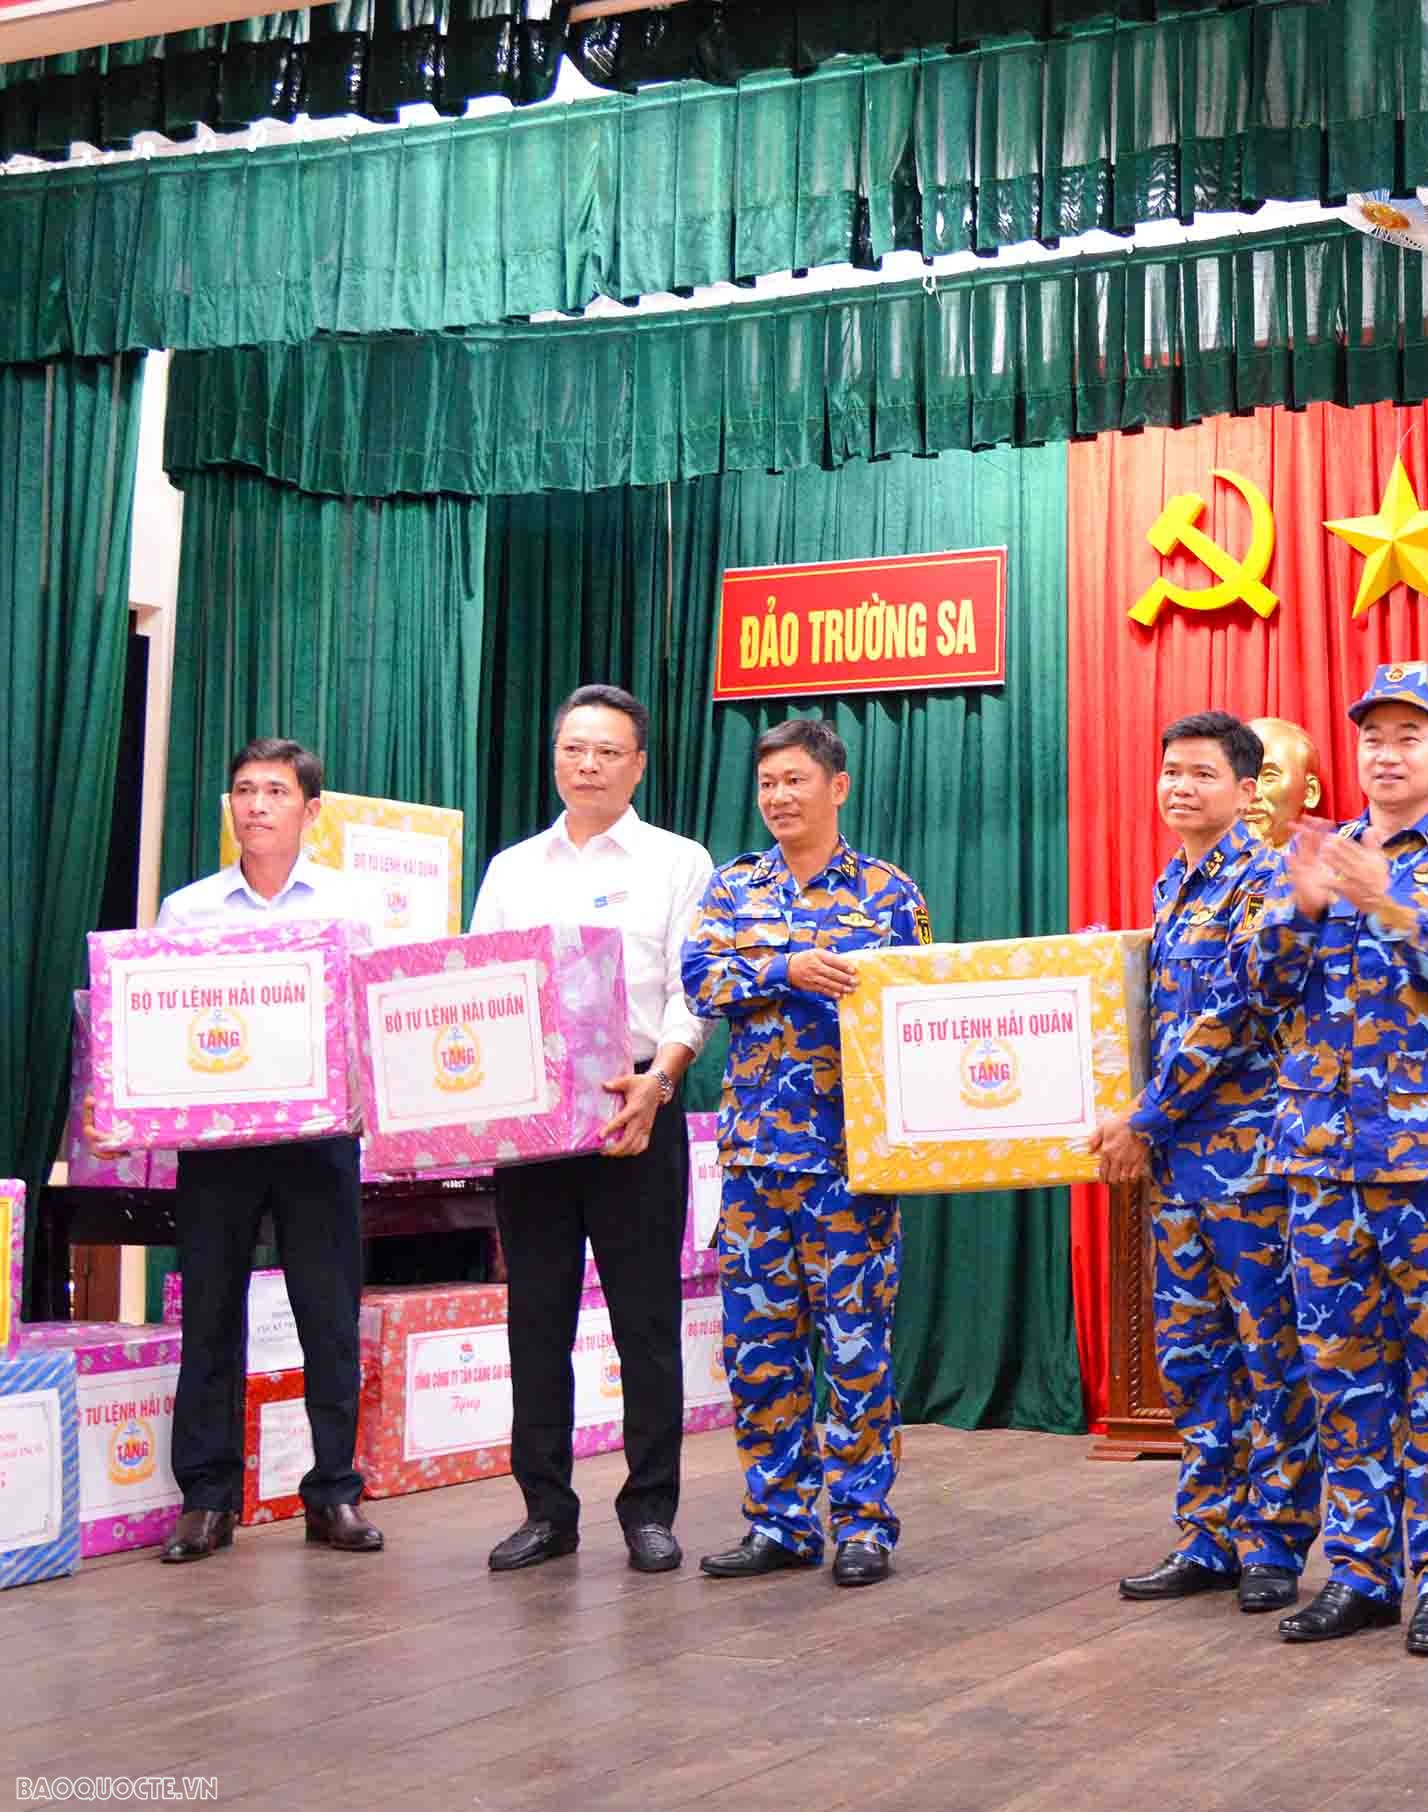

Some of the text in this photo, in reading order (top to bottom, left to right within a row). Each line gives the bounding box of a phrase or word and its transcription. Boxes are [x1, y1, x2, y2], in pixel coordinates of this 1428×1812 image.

[739, 592, 977, 670] ĐẢO TRƯỜNG SA
[131, 980, 305, 1015] BỘ TƯ LỆNH HẢI QUÂN
[405, 1008, 422, 1031] TƯ
[903, 1009, 1073, 1047] BỘ TƯ LỆNH HẢI QUÂN
[968, 1061, 1010, 1086] TẶNG
[86, 1404, 101, 1426] TƯ
